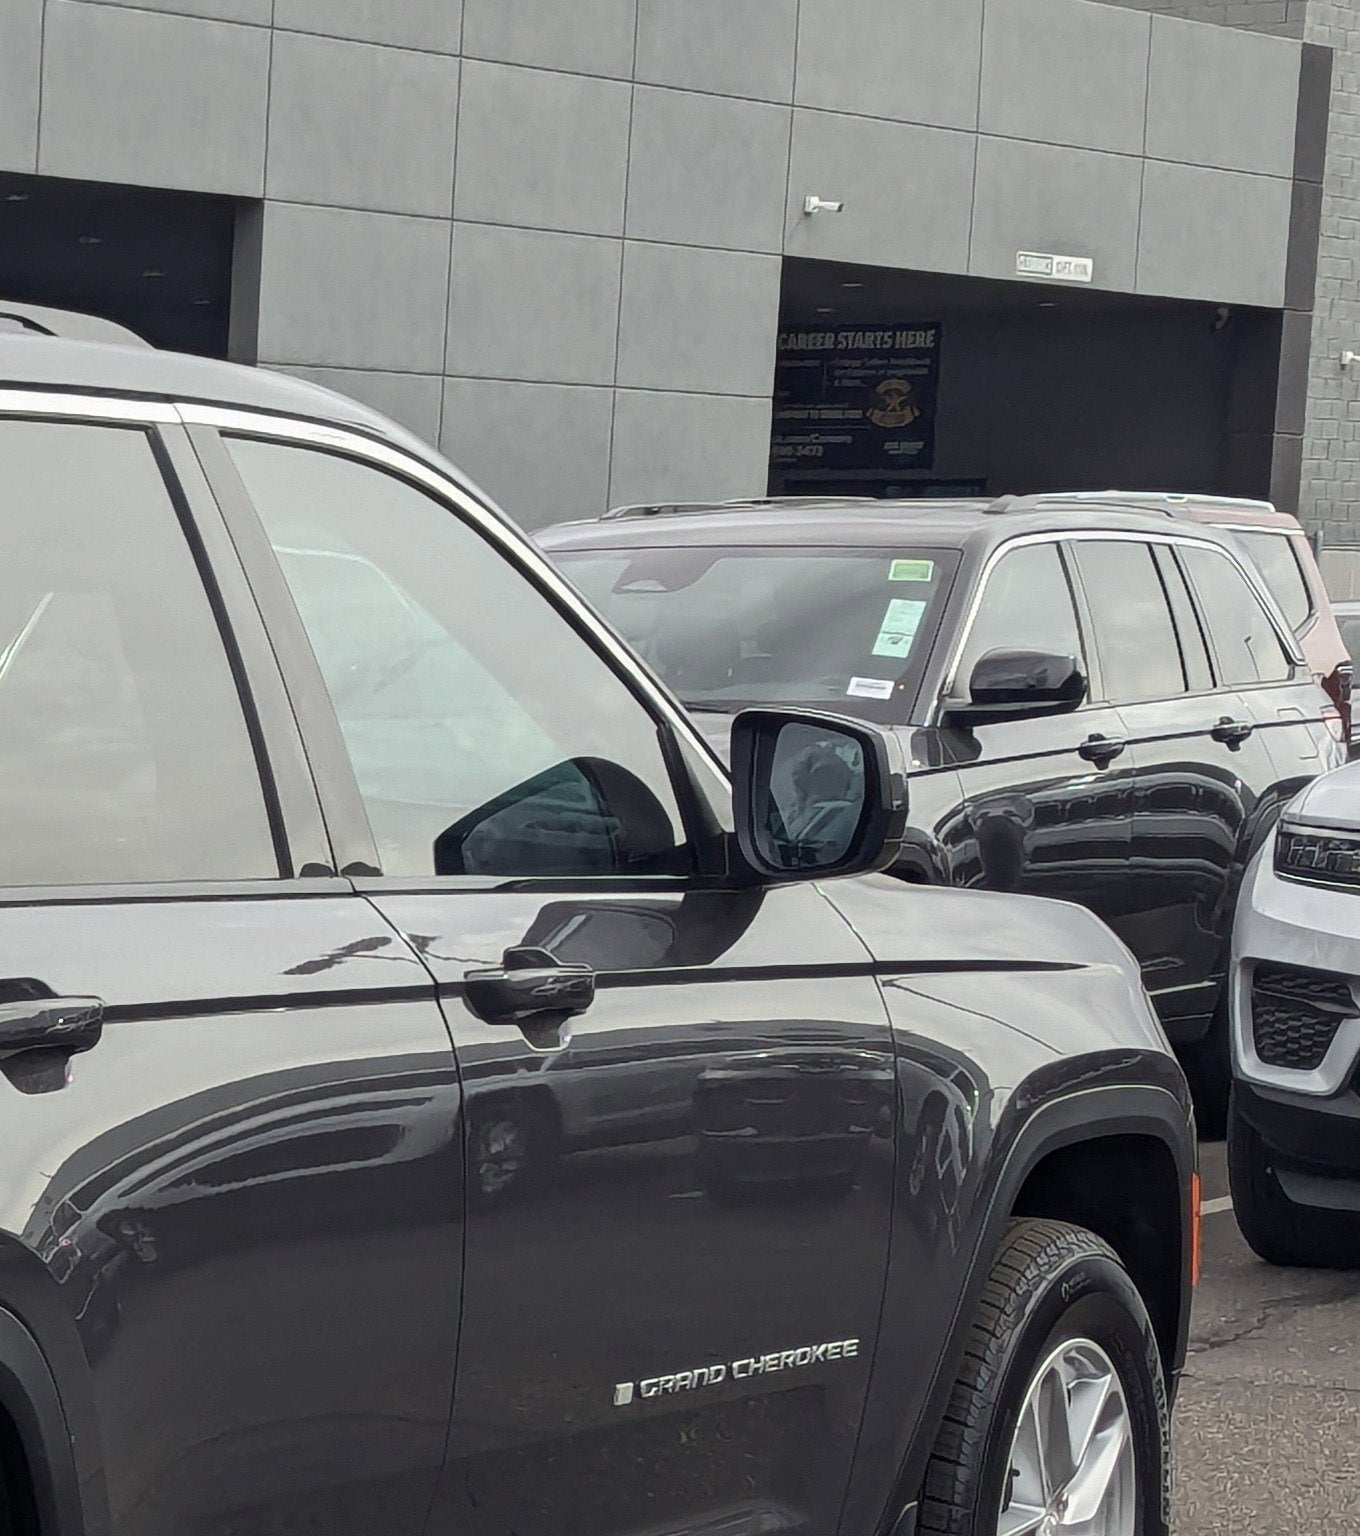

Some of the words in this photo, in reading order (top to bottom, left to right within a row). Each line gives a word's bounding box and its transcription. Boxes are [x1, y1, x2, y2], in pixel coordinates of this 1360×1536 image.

[834, 331, 893, 349] STARTS
[895, 329, 935, 349] HERE
[640, 1365, 727, 1398] GRAND
[732, 1338, 860, 1379] CHEROKEE
